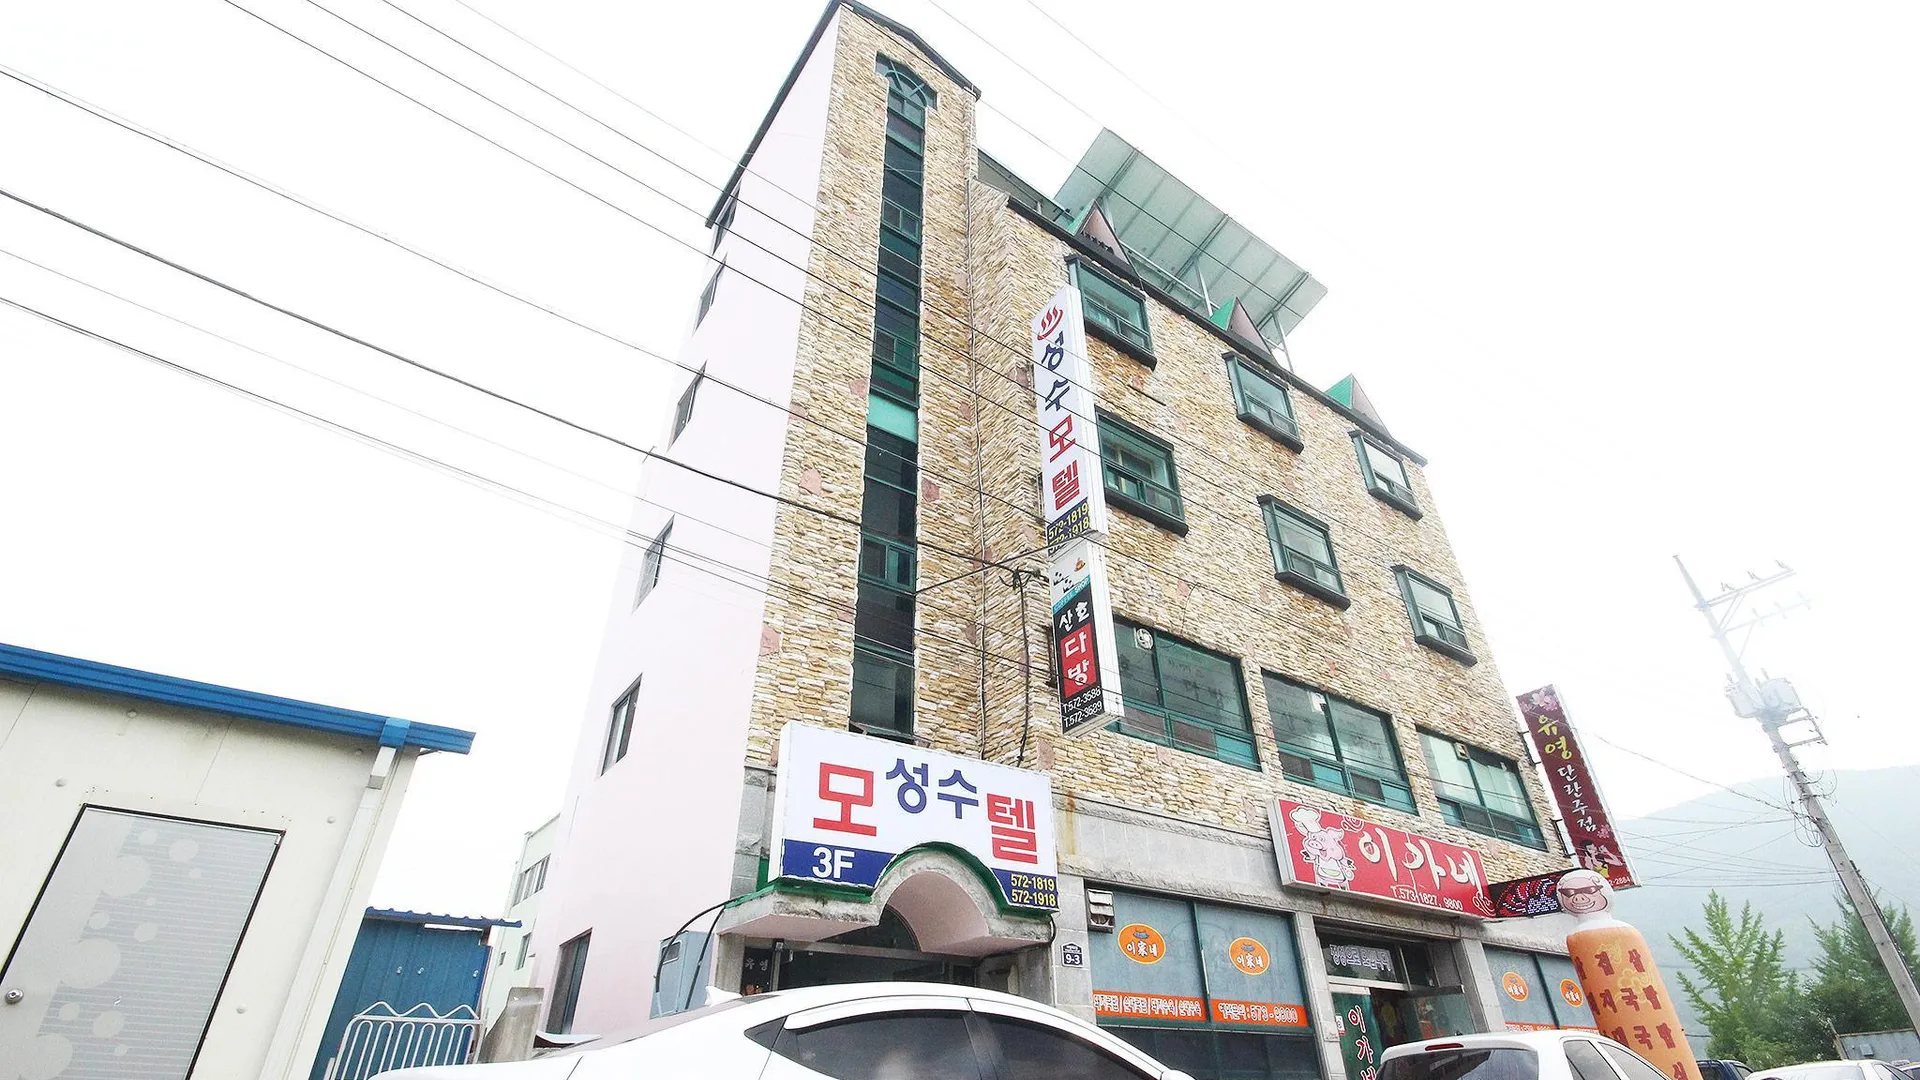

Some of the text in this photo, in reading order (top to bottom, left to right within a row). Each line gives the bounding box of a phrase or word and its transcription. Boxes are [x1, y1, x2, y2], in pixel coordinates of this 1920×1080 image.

[1049, 502, 1088, 540] 572-1819
[1058, 601, 1090, 632] 산호
[1064, 630, 1089, 686] 다방
[1557, 764, 1597, 832] 단란주점
[812, 847, 855, 879] 3F
[1011, 873, 1055, 892] 572-1819
[1012, 889, 1056, 906] 572-1918
[1066, 953, 1081, 965] 9-3
